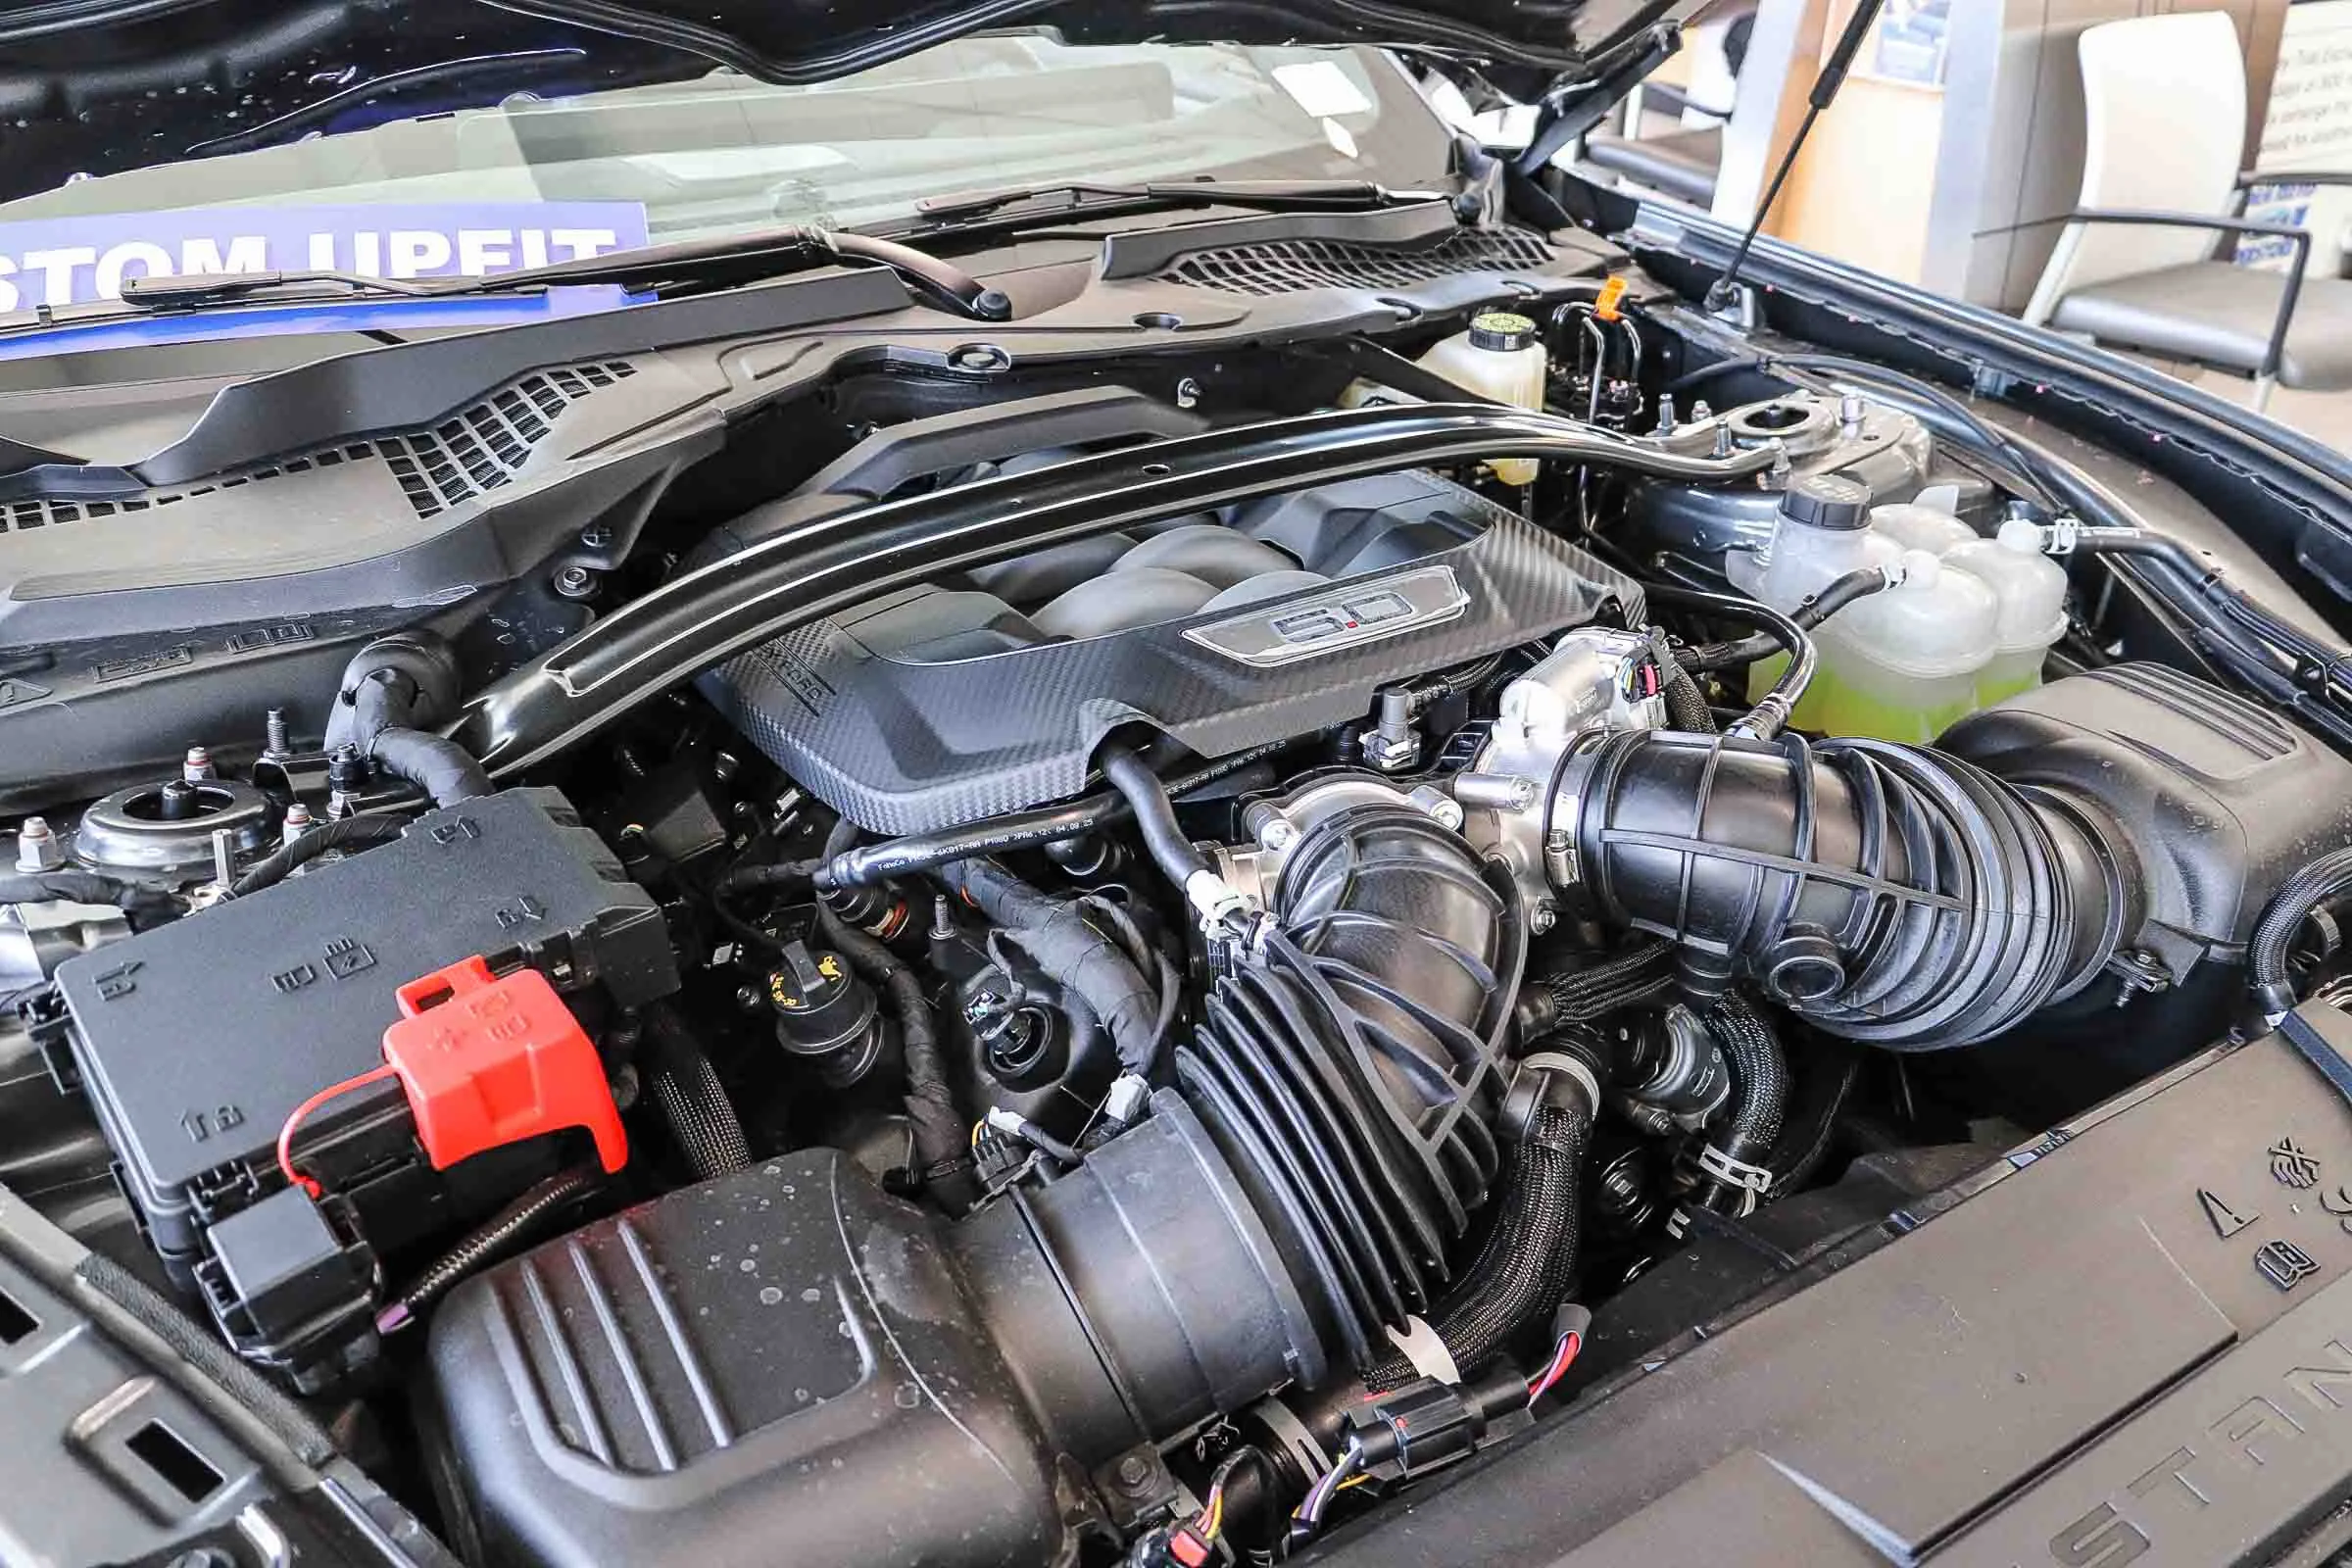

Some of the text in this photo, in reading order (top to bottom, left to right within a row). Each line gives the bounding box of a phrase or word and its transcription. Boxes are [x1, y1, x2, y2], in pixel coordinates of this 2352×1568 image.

[0, 227, 616, 312] TOM UPFIT
[1273, 592, 1413, 643] 5.0
